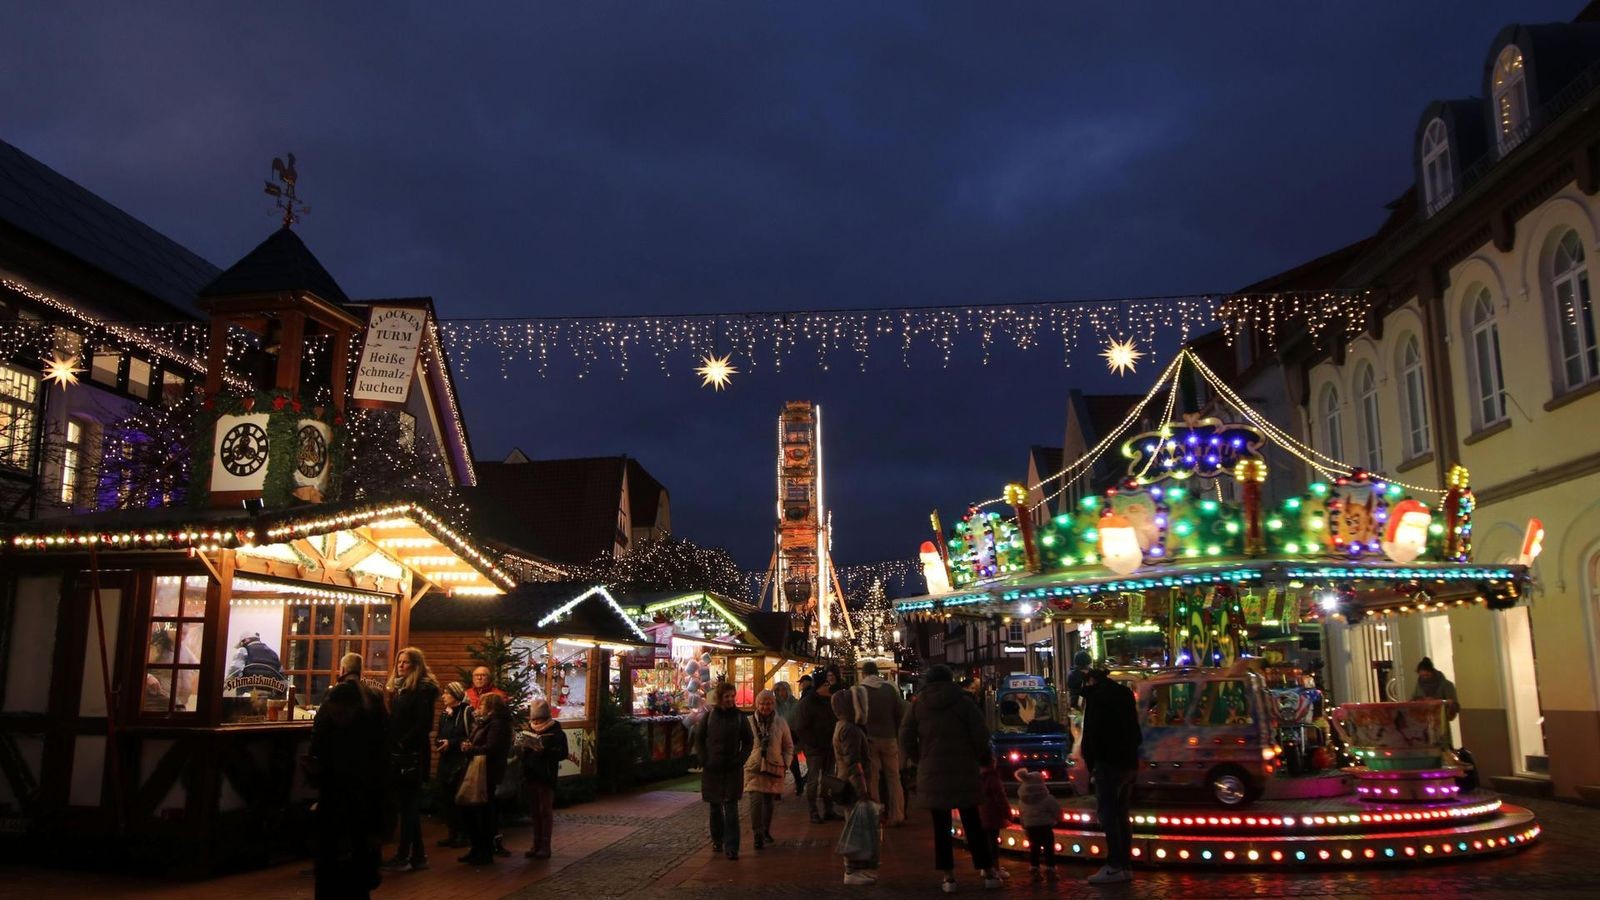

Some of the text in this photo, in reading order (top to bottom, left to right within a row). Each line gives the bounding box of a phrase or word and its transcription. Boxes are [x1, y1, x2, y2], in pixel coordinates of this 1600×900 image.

[370, 310, 421, 331] GLOCKEN
[376, 330, 413, 342] TURM
[369, 352, 406, 365] Heiße
[359, 366, 411, 379] Schmalz-
[358, 381, 404, 395] kuchen
[226, 674, 285, 692] Schmalzkuchen
